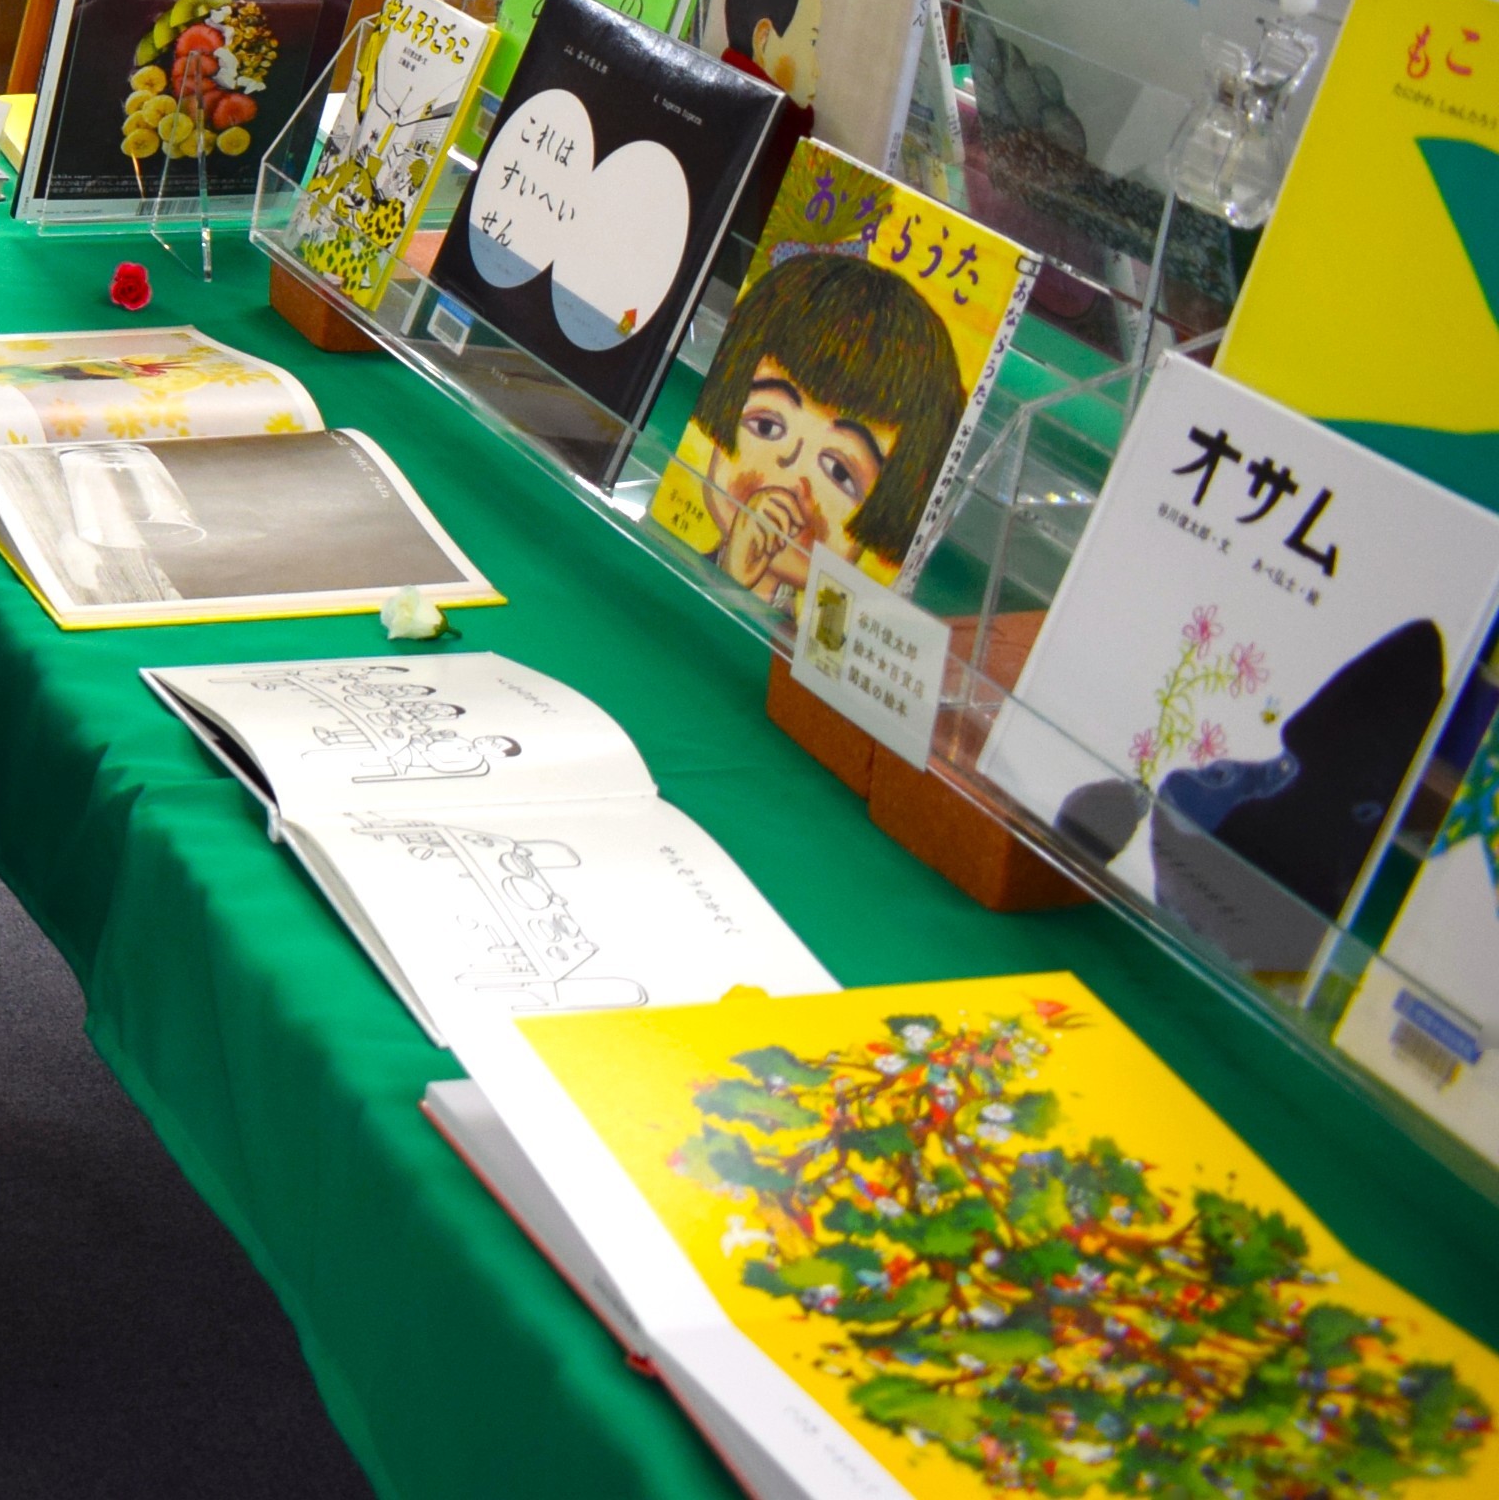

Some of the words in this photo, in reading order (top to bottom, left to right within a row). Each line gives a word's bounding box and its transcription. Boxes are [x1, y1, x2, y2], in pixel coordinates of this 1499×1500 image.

[1406, 22, 1481, 81] もこ
[521, 116, 576, 168] これは
[502, 159, 577, 222] すいへい
[480, 209, 513, 248] せん
[805, 169, 981, 306] おならうた
[971, 279, 1031, 407] おならうた
[1157, 501, 1231, 556] 谷川俊太郎・文
[1172, 426, 1339, 578] オサム
[857, 610, 919, 661] 谷川俊太郎
[848, 664, 909, 719] 関連の絵本
